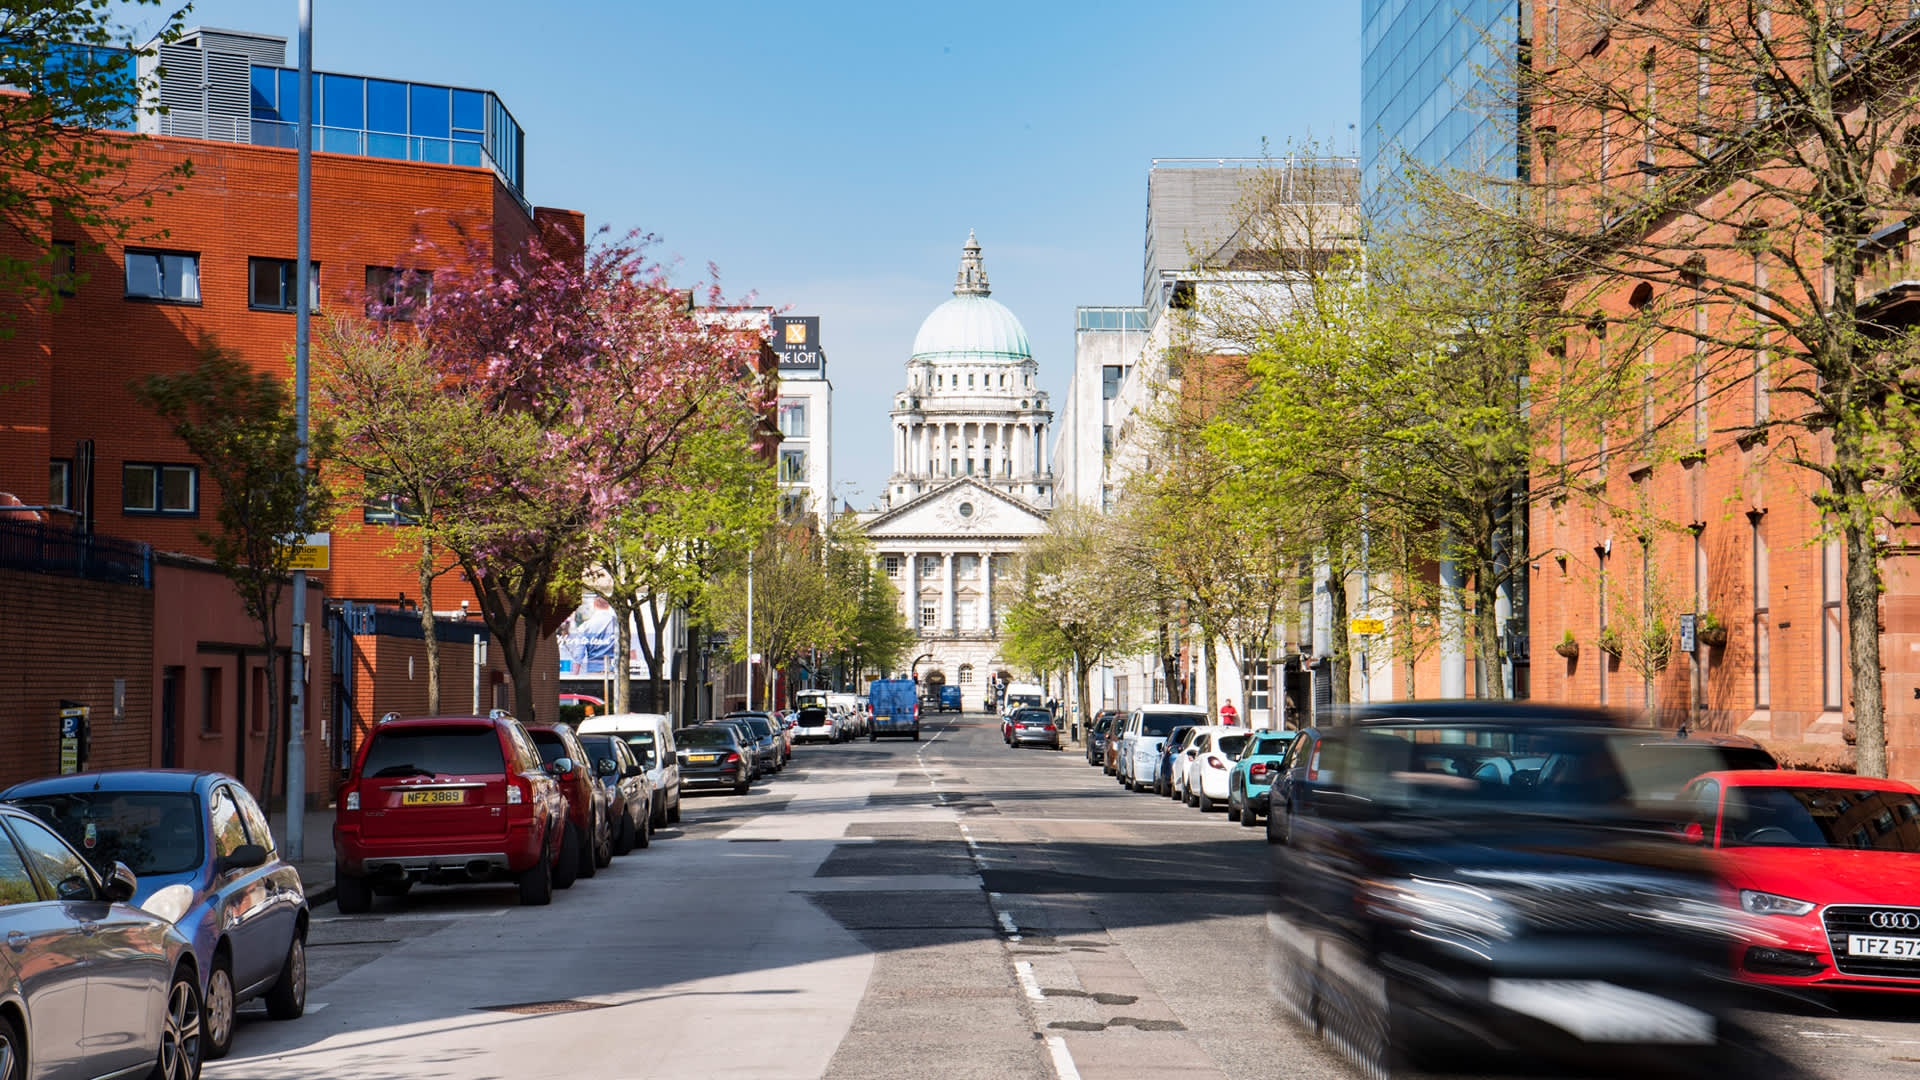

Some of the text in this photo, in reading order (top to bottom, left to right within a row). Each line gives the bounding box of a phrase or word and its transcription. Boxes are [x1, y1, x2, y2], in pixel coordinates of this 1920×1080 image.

[788, 325, 804, 342] X
[794, 351, 816, 364] LOFT
[407, 792, 429, 802] NFZ
[1856, 938, 1889, 954] TFZ
